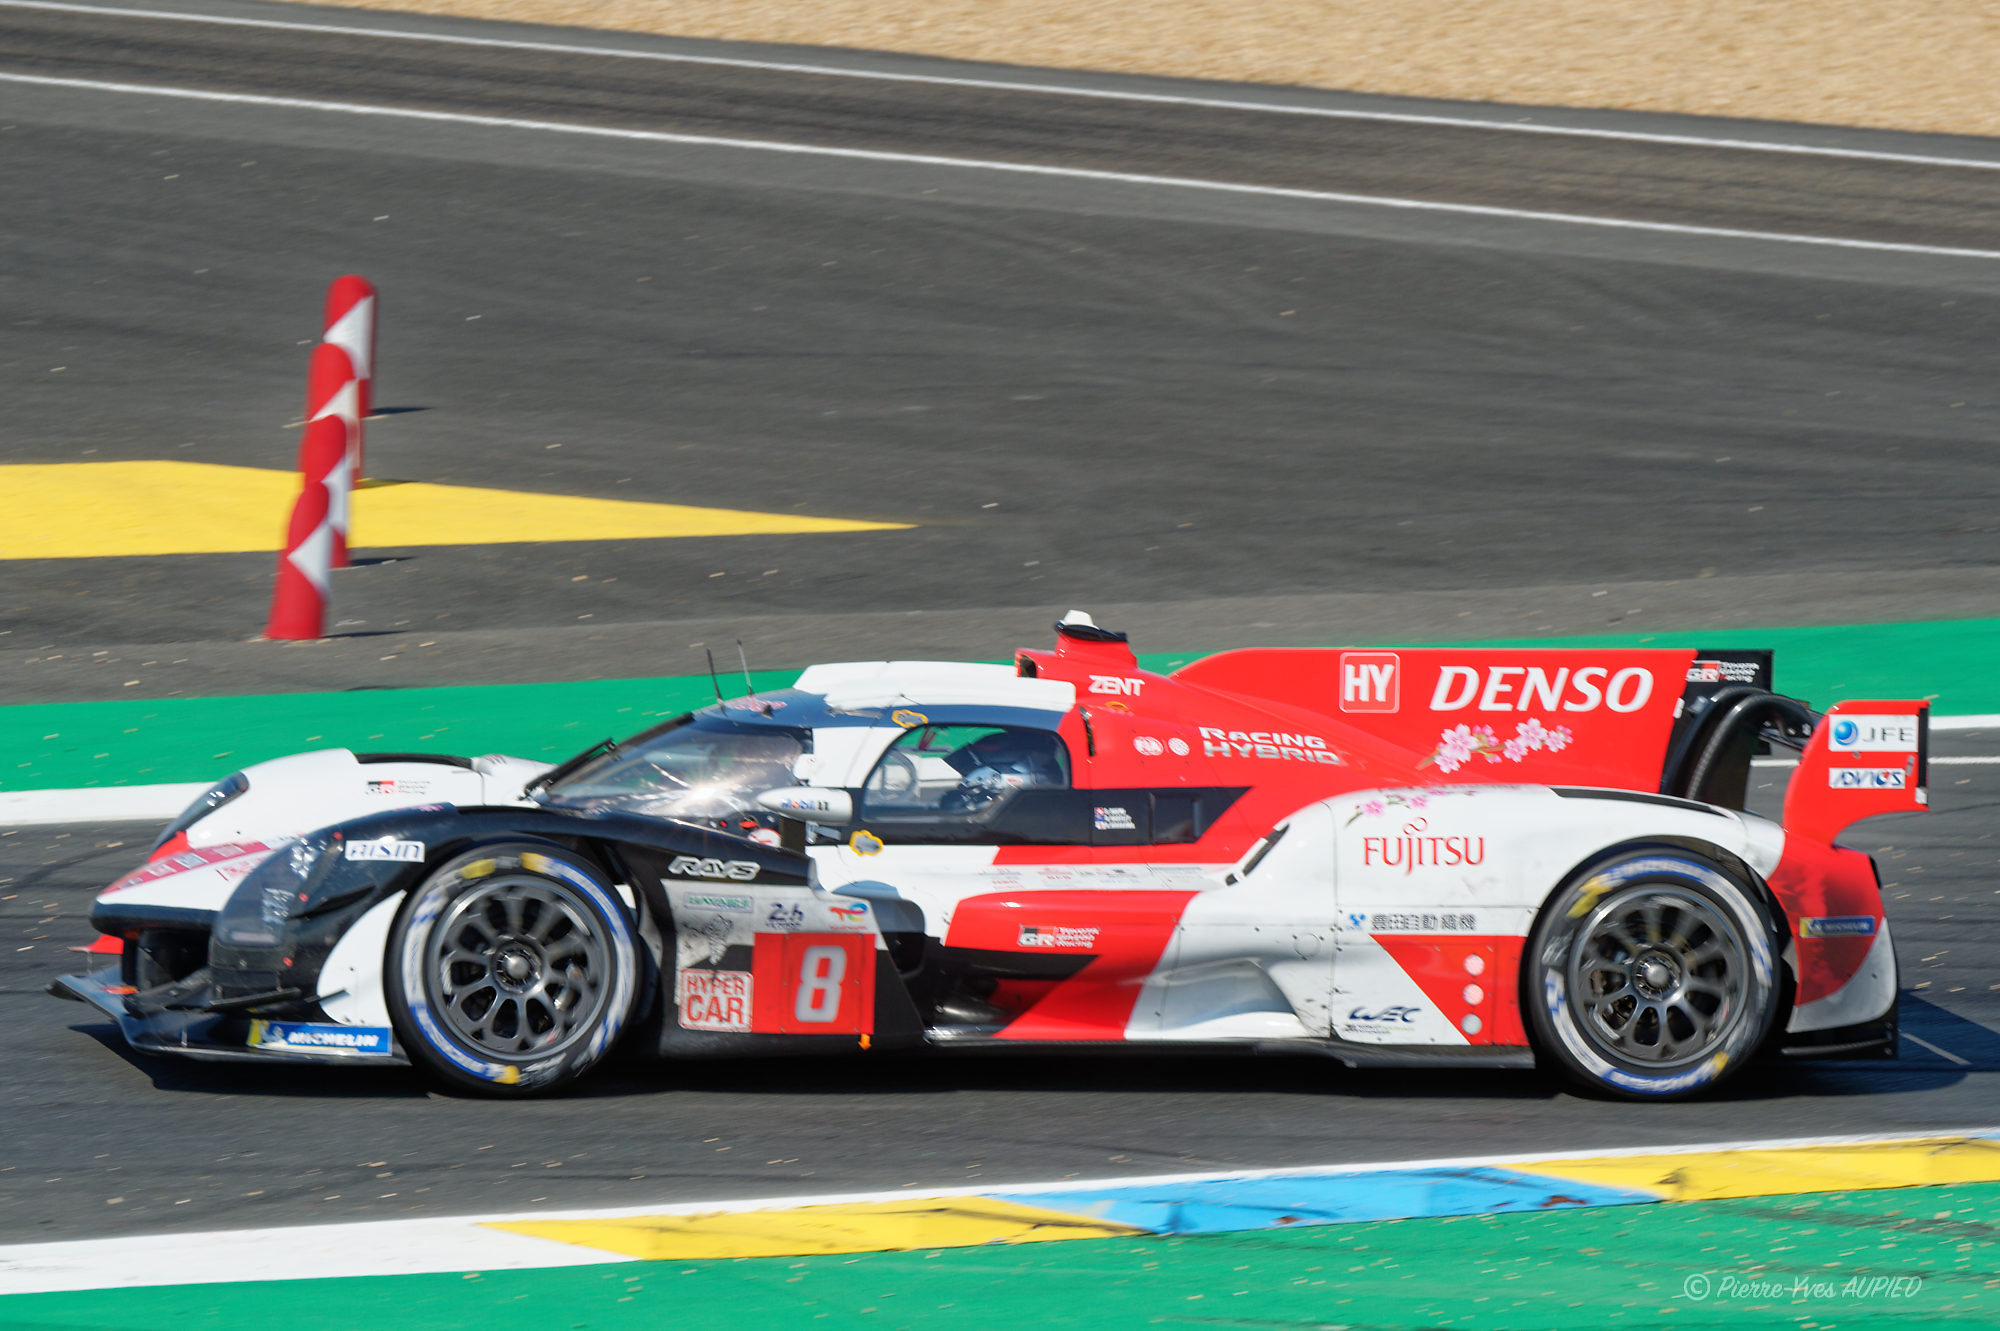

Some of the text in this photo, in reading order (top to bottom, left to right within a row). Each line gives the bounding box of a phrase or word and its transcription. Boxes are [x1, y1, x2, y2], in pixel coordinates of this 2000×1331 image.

[1088, 674, 1145, 696] ZENT
[1344, 664, 1395, 702] HY
[1429, 665, 1654, 713] DENSO
[1198, 726, 1327, 749] RACING
[1862, 727, 1914, 742] JFE
[1203, 740, 1340, 765] HYBRID
[1832, 770, 1902, 786] ADVICS
[1363, 836, 1485, 876] FUJITSU
[668, 856, 761, 880] RAYS
[687, 975, 744, 995] HYPER
[795, 945, 847, 1022] 8
[686, 994, 744, 1024] CAR
[1349, 1005, 1421, 1023] WEC
[288, 1031, 380, 1047] MICHELIN
